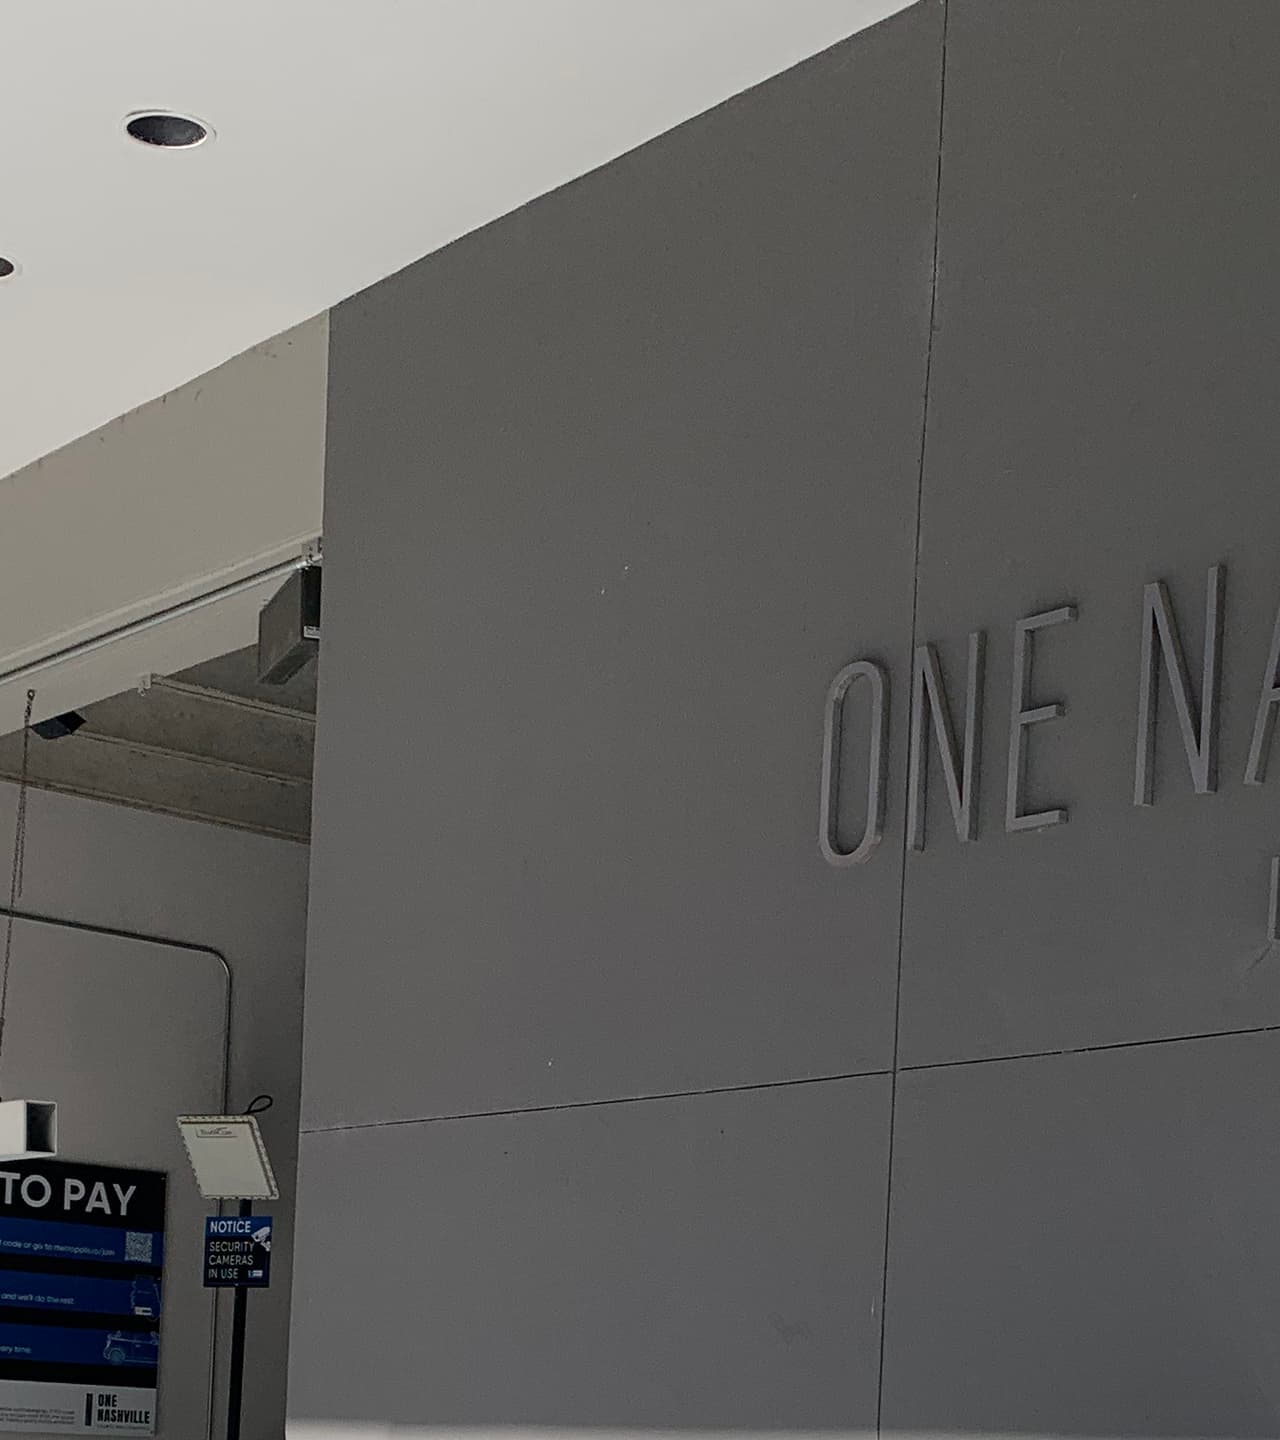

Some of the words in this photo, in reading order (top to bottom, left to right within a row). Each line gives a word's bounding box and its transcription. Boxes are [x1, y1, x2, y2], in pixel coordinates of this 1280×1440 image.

[817, 605, 1077, 868] ONE
[64, 1178, 137, 1216] PAY
[209, 1220, 251, 1233] NOTICE
[3, 1239, 21, 1248] code
[209, 1241, 255, 1252] SECURITY
[208, 1254, 254, 1266] CAMERAS
[208, 1268, 218, 1279] IN
[220, 1268, 239, 1280] USE
[1, 1292, 17, 1300] and
[97, 1393, 117, 1408] ONE
[96, 1409, 150, 1425] NASHVILLE
